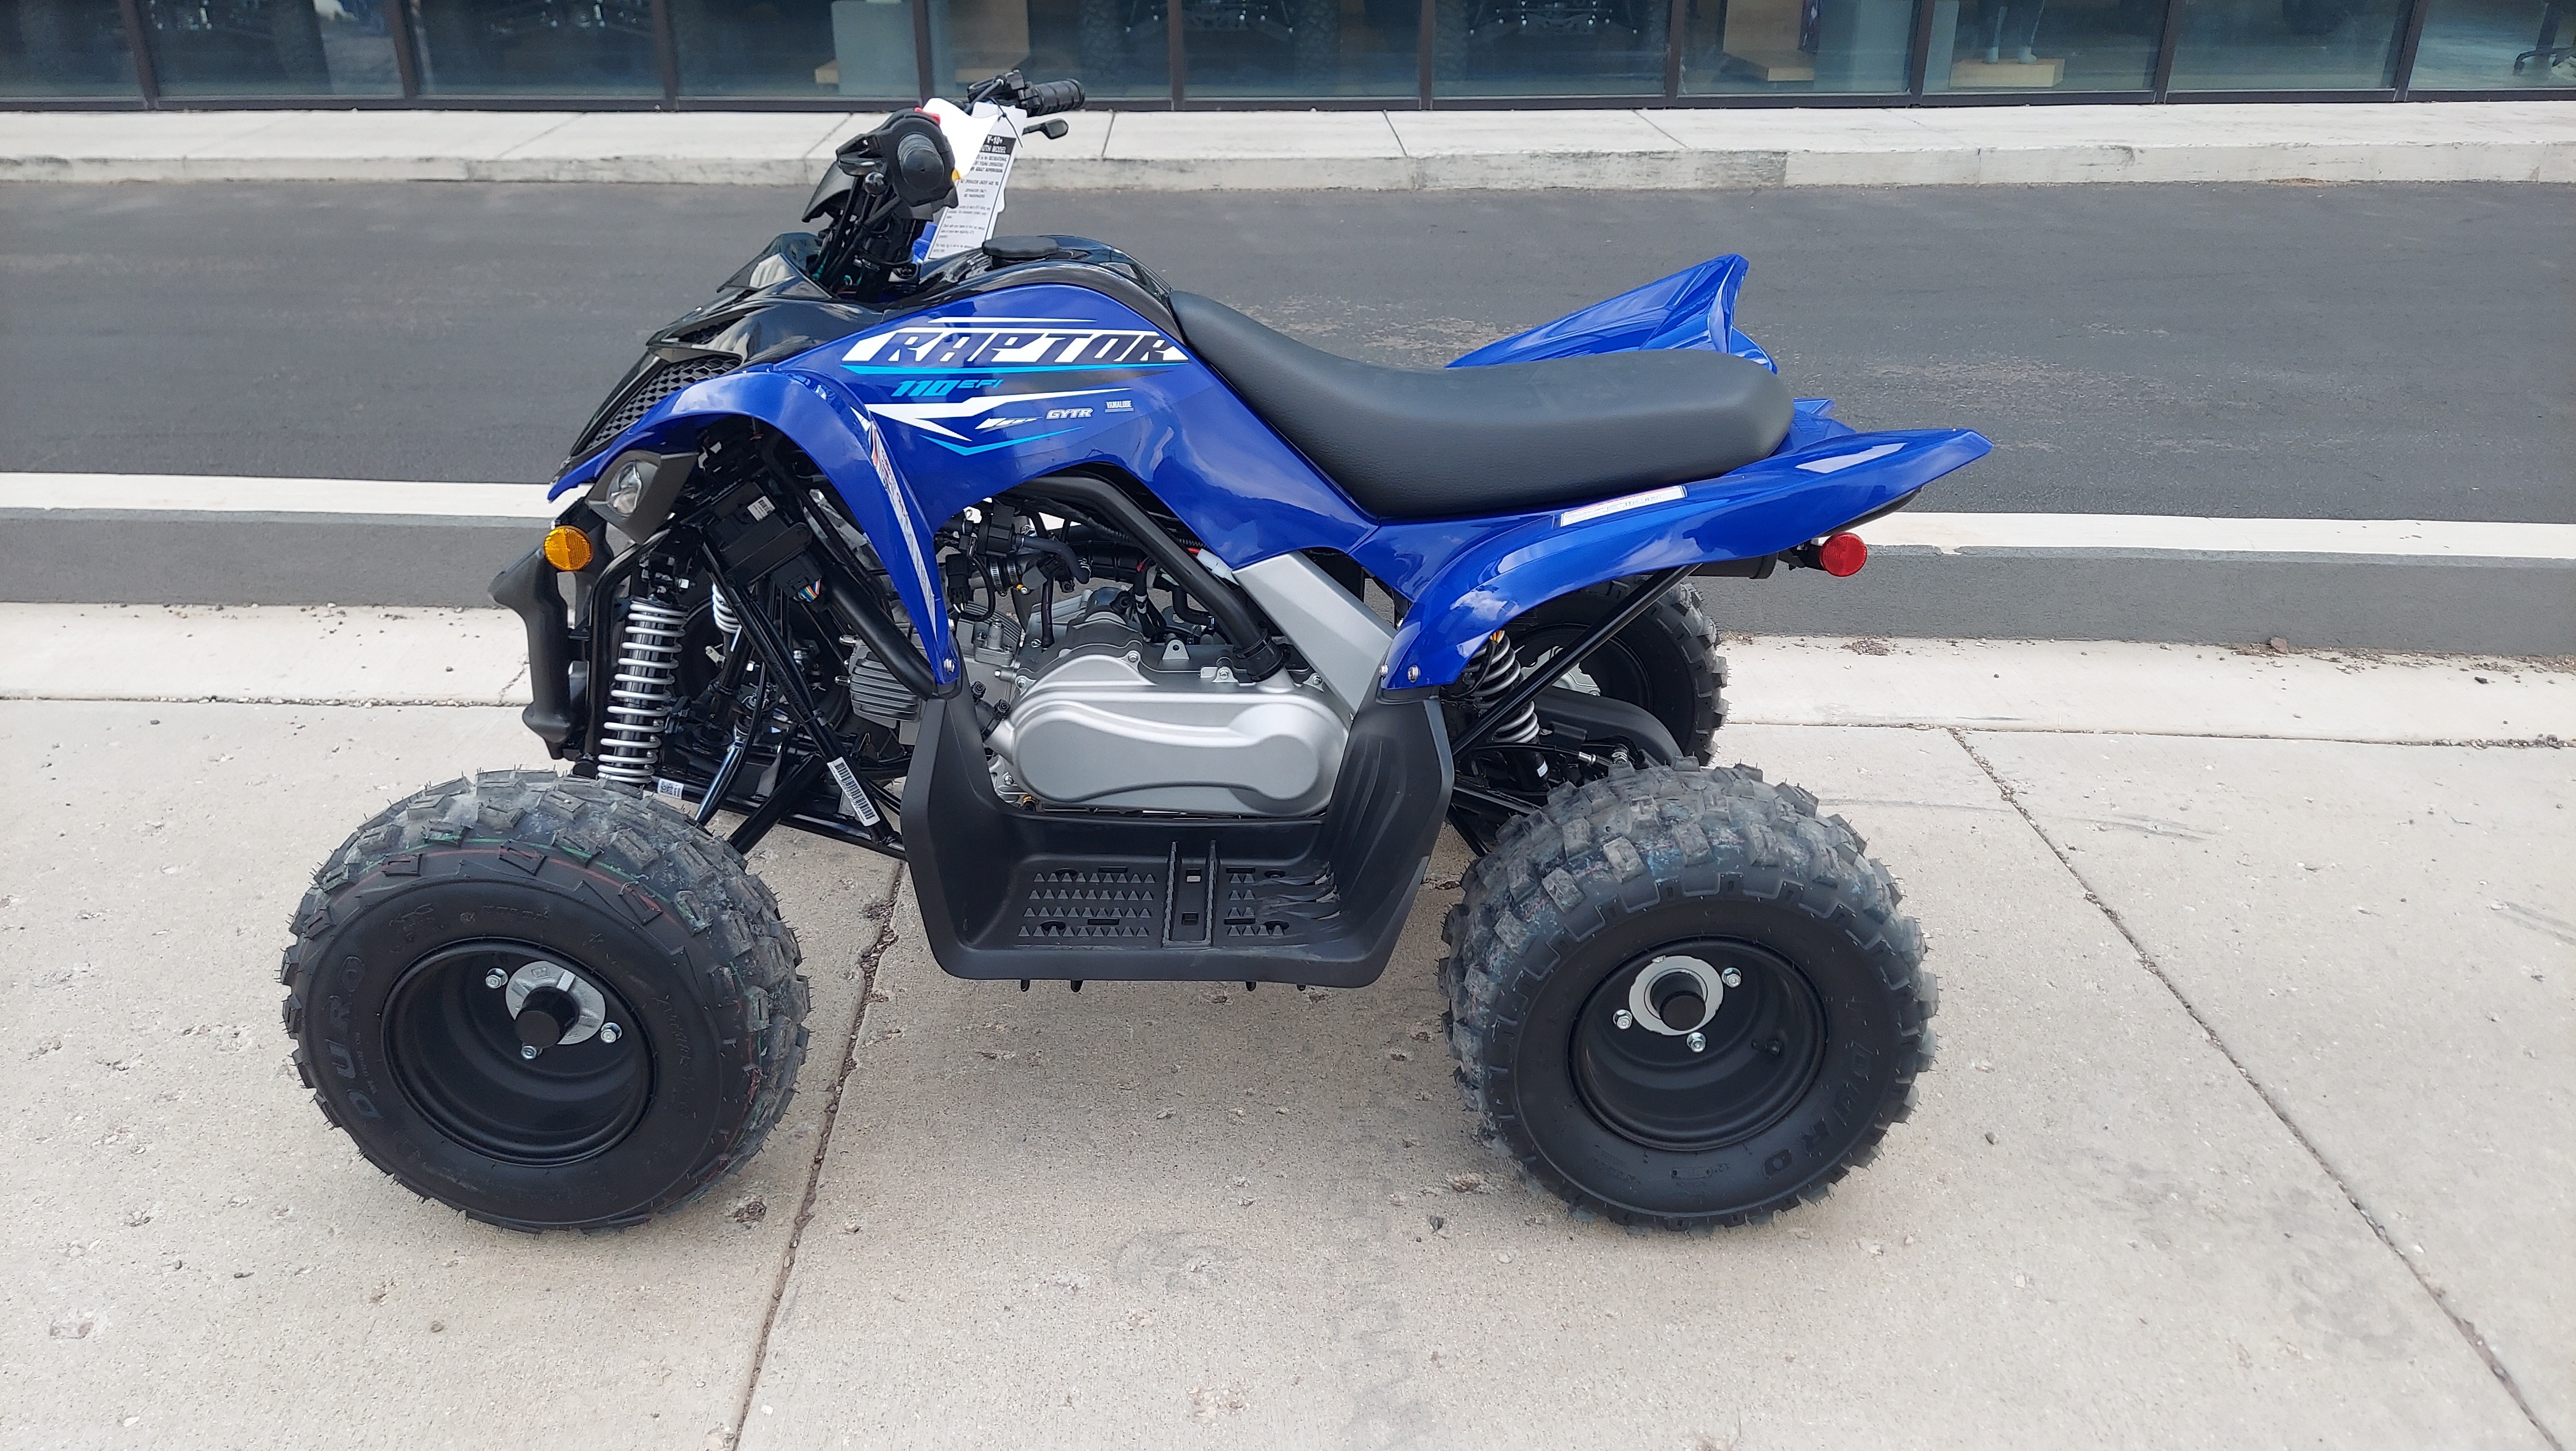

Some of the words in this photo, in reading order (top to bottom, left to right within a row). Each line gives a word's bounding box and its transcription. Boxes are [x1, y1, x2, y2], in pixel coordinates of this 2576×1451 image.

[865, 332, 1181, 365] RAPTOR
[891, 379, 960, 397] 110
[1045, 407, 1093, 420] GYTR
[322, 955, 384, 1120] DURO
